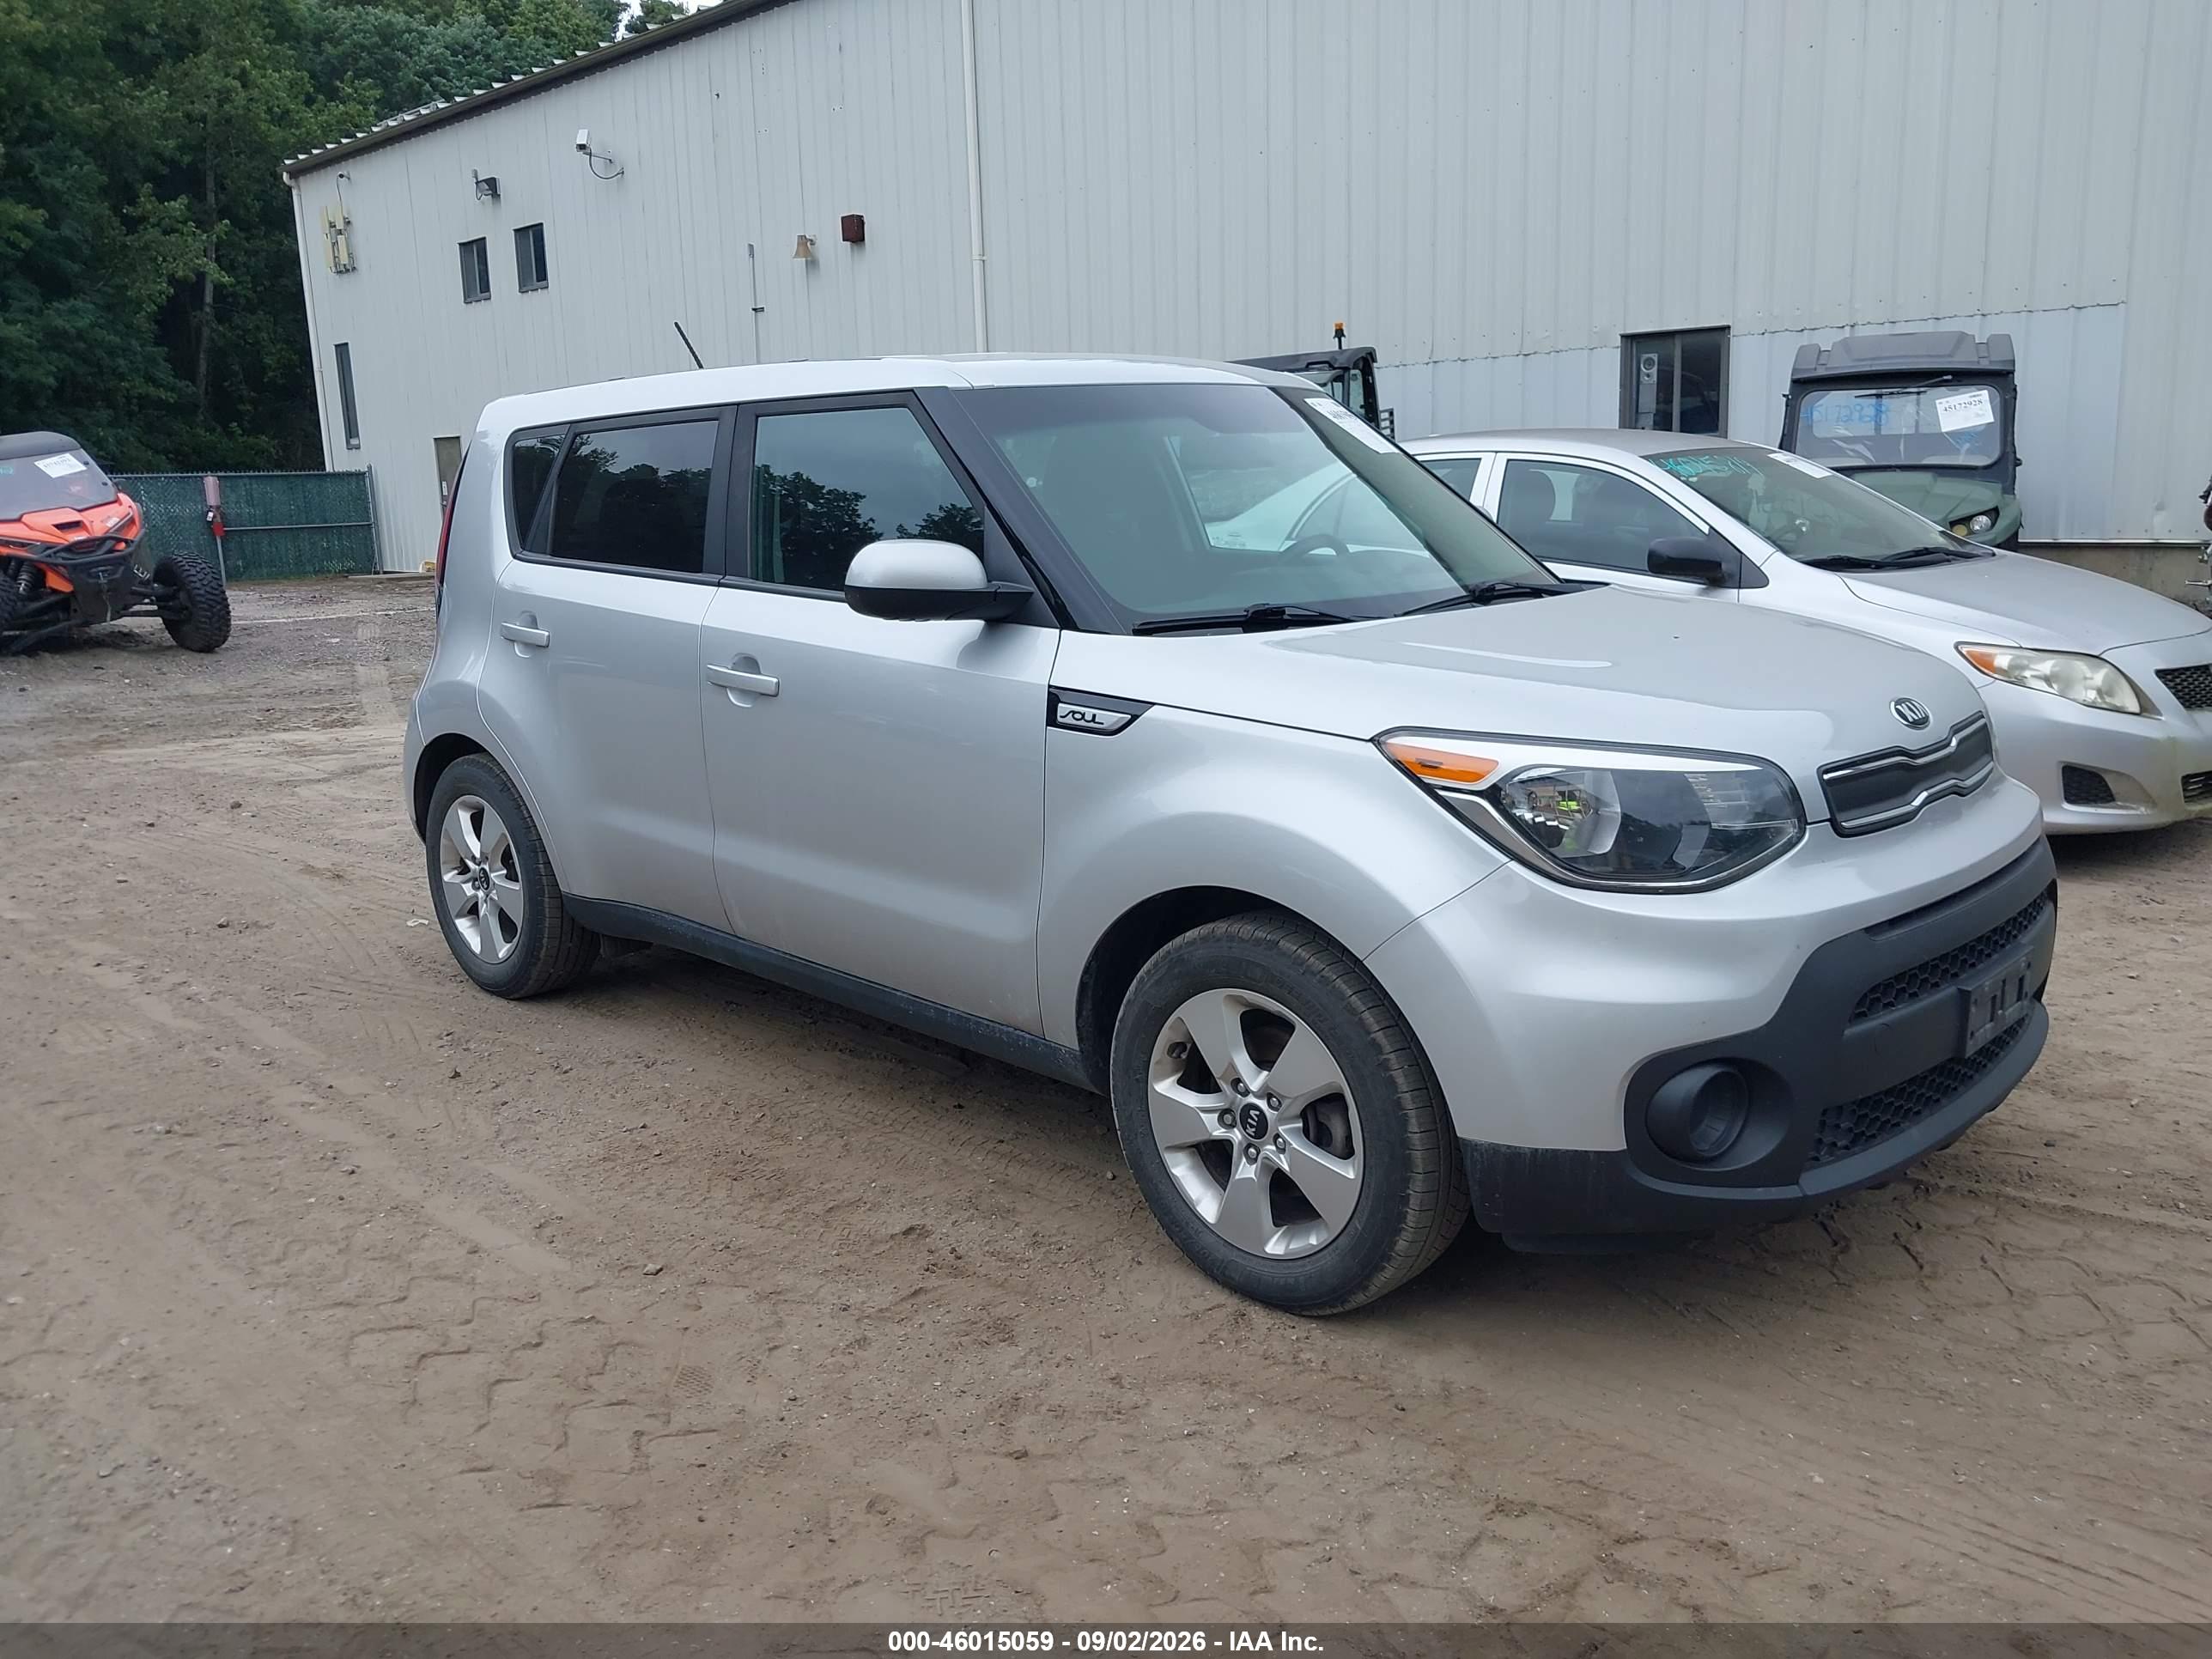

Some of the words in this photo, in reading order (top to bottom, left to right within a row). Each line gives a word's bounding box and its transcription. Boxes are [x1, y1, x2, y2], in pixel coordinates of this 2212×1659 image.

[1943, 398, 1984, 413] 45172928
[1894, 700, 1930, 723] KIA
[1245, 1109, 1261, 1136] KIA
